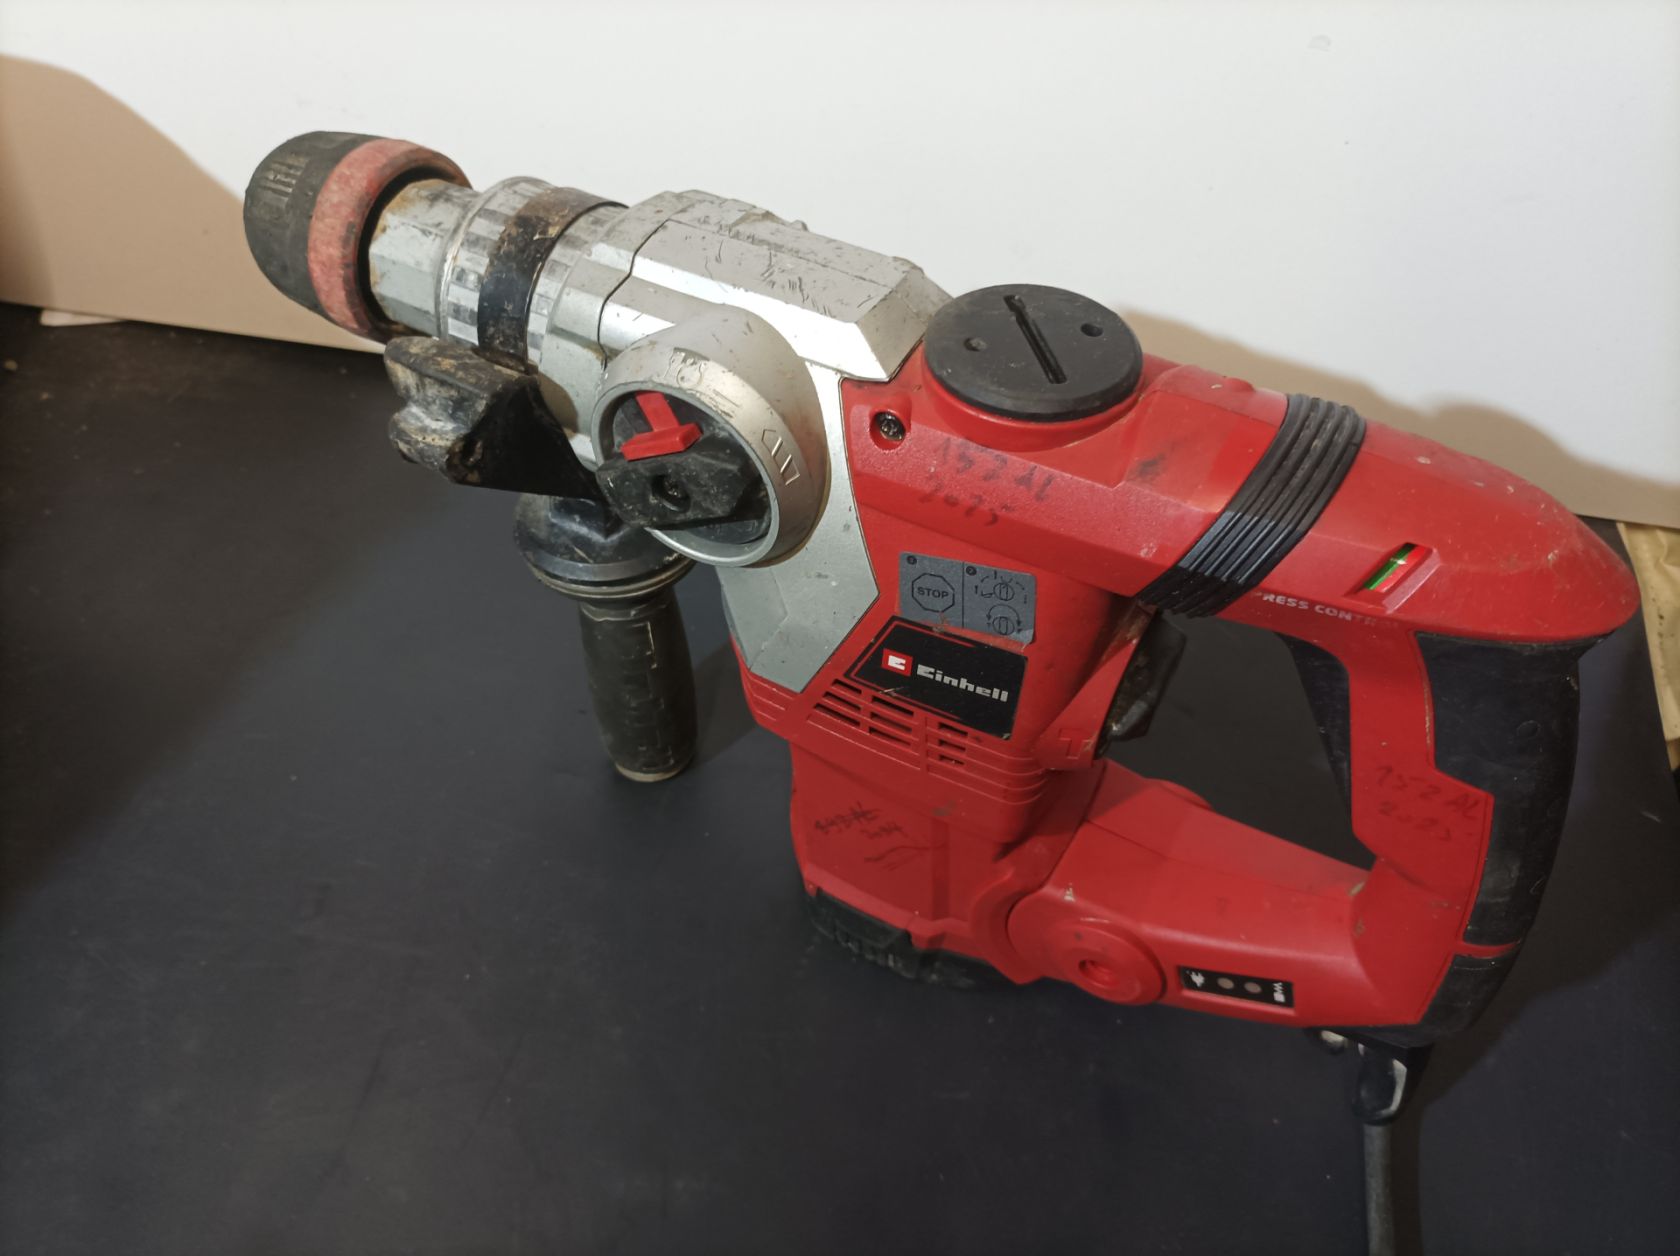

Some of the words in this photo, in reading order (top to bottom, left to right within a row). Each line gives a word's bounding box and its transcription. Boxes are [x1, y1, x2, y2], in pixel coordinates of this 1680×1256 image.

[917, 586, 949, 600] STOP
[1254, 591, 1309, 610] RESS
[916, 663, 1009, 703] Einhell
